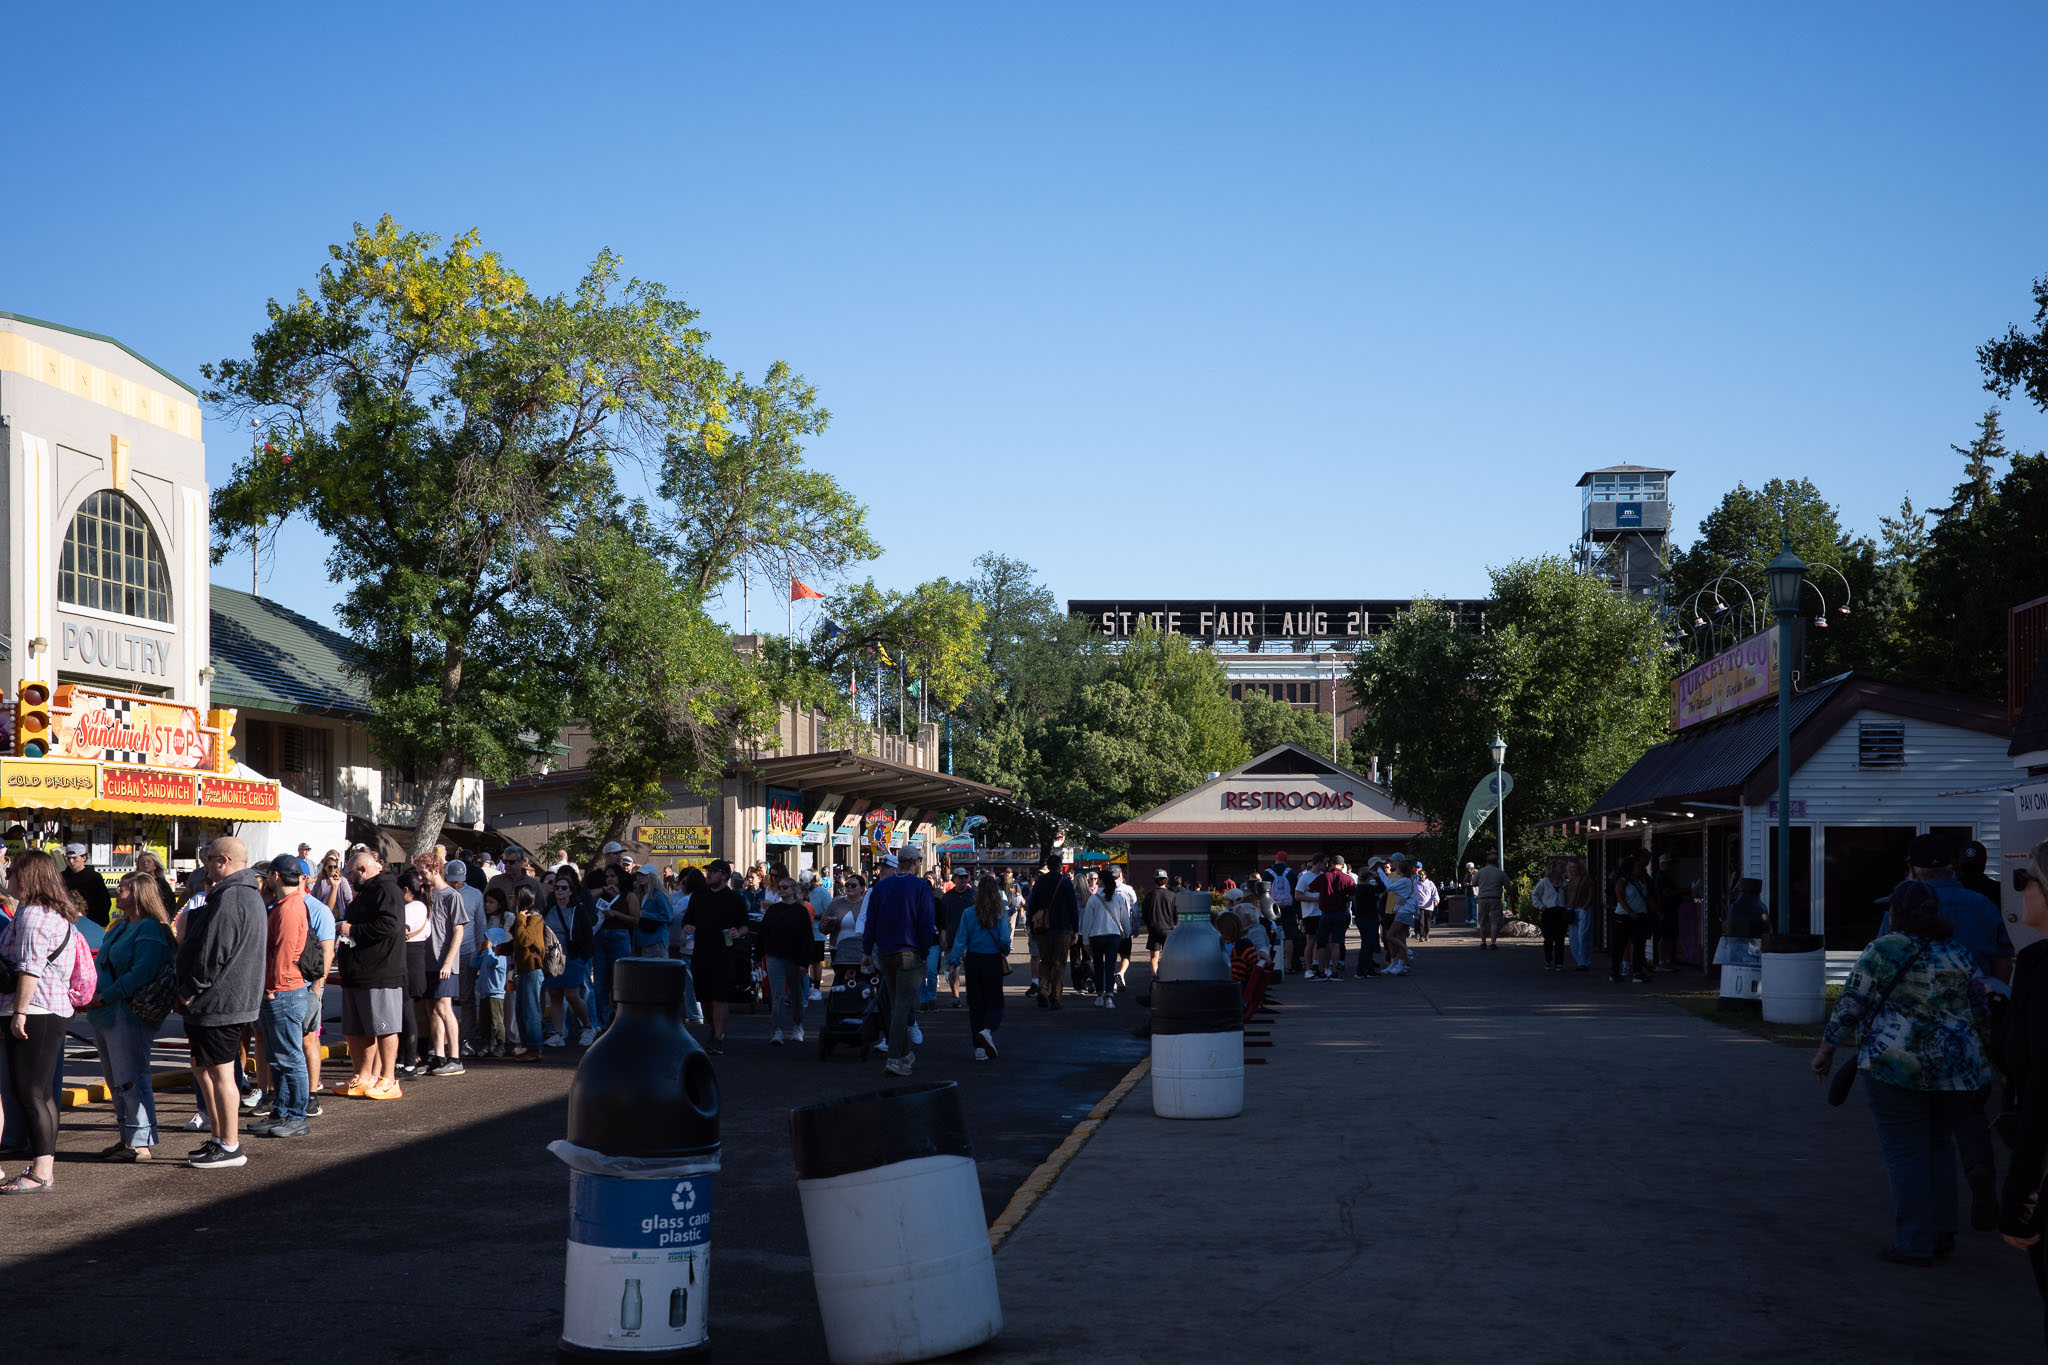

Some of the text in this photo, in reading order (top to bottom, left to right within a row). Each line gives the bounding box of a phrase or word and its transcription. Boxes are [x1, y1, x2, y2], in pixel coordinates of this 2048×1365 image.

[1102, 611, 1181, 636] STATE
[1200, 611, 1254, 636] FAIR
[1282, 611, 1327, 636] AUG
[1347, 611, 1369, 636] 21
[63, 622, 171, 676] POULTRY
[1680, 656, 1724, 703] TURKEY
[1727, 647, 1743, 672] TO
[1747, 637, 1768, 666] GO
[92, 709, 112, 727] The
[76, 713, 194, 756] Sandwich STOP
[174, 735, 185, 748] STOP
[7, 774, 93, 790] COLD DRINKS
[107, 780, 190, 801] CUBAN SANDWICH
[221, 790, 274, 806] MONTE CRISTO
[1226, 791, 1354, 809] RESTROOMS
[653, 827, 697, 835] STEICHEN'S
[1012, 851, 1041, 860] DONU
[641, 1211, 710, 1233] glass cans
[659, 1227, 701, 1246] plastic
